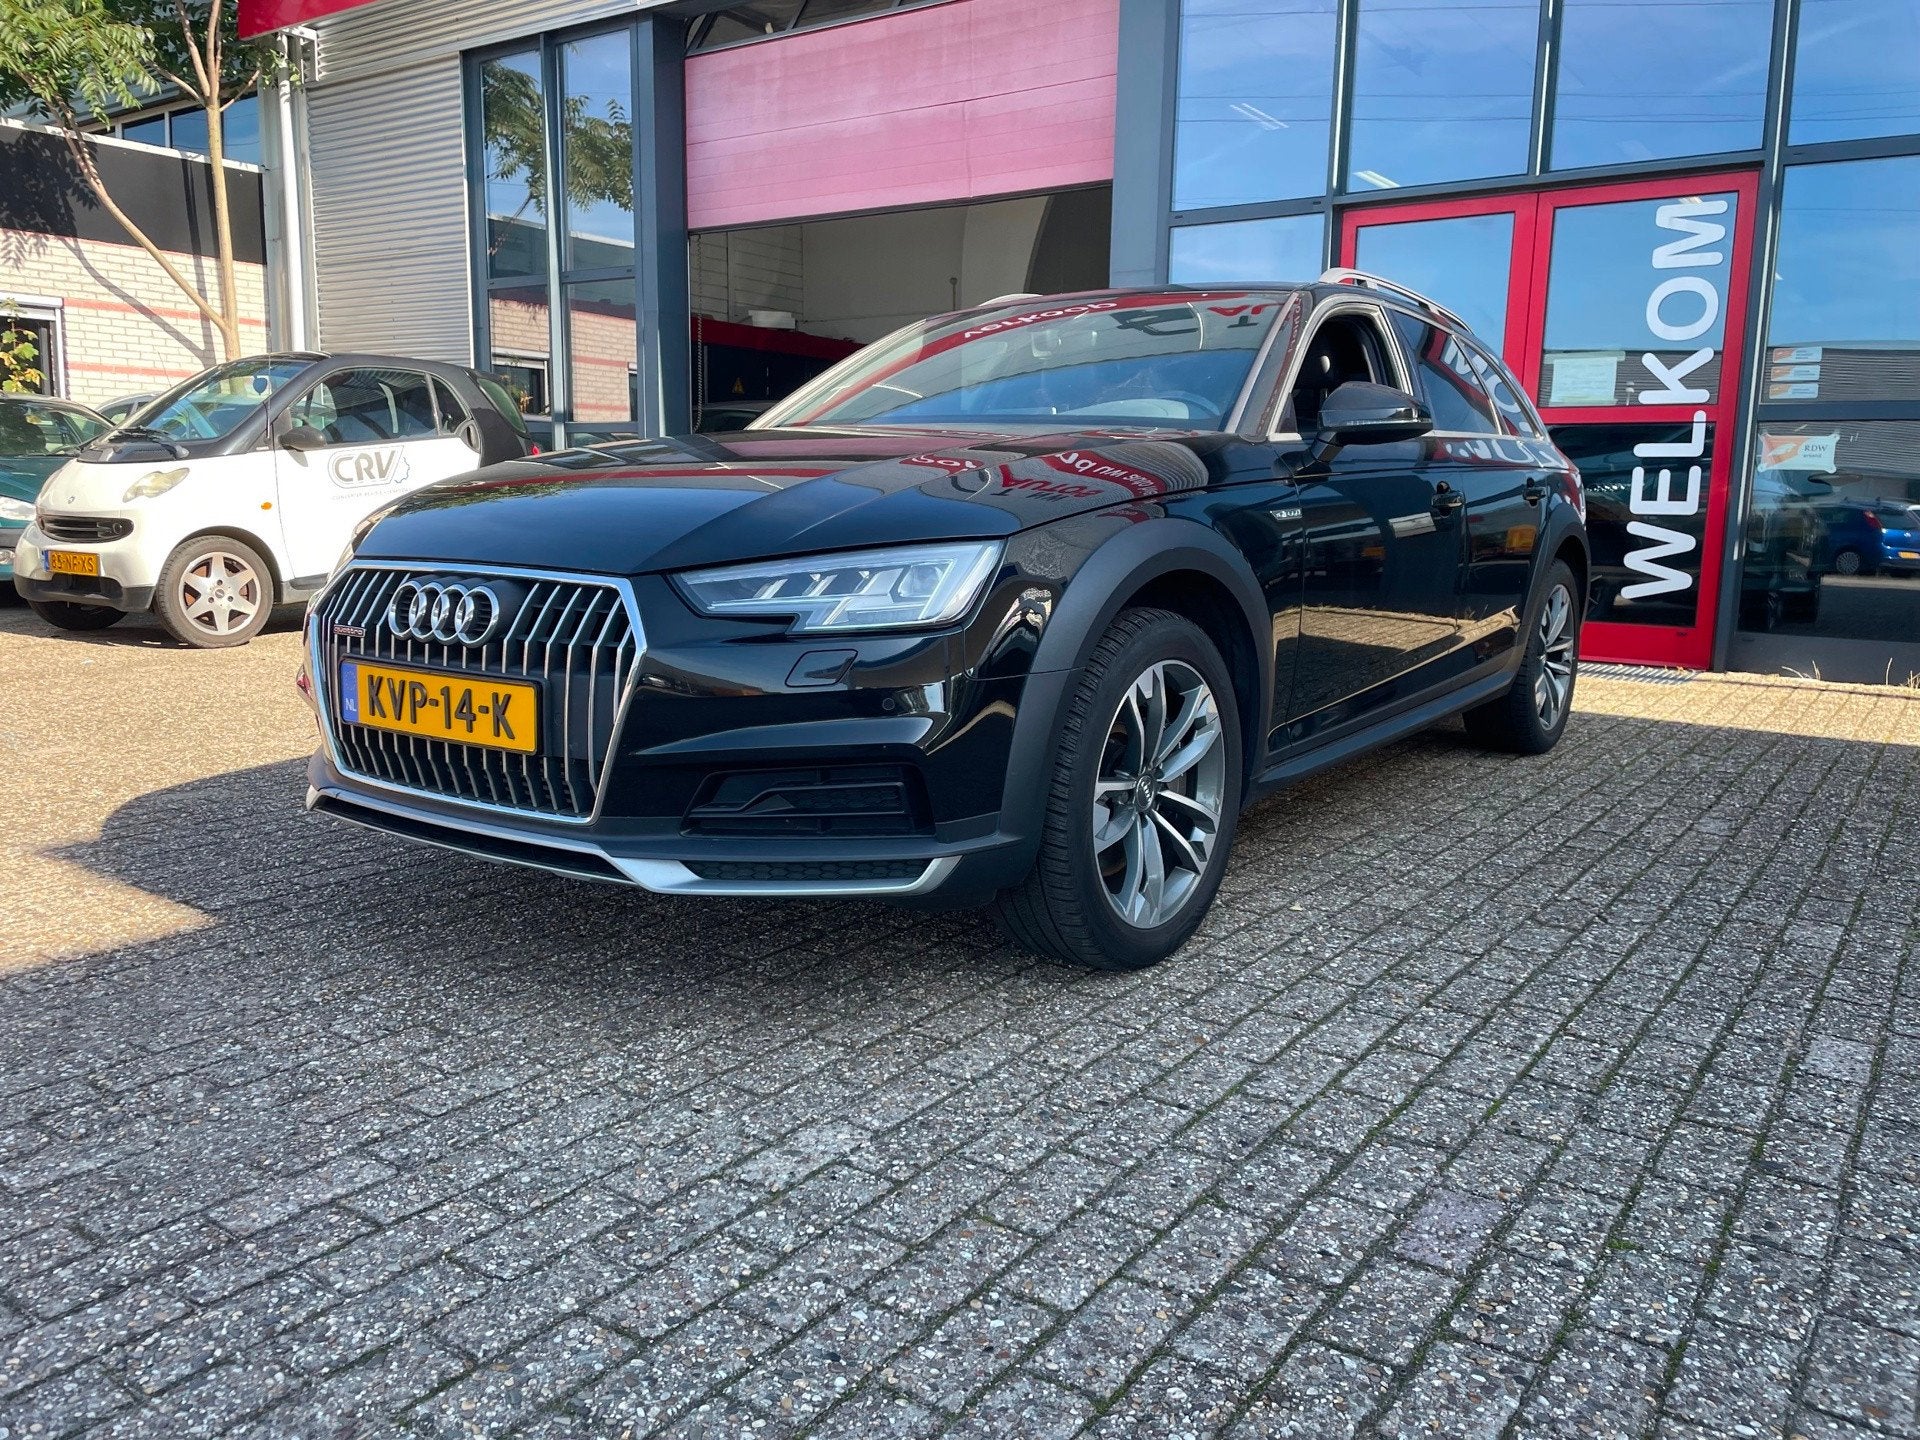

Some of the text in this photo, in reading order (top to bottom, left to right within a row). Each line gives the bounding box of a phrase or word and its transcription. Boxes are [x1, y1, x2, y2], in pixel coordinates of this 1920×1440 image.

[1620, 199, 1728, 600] WELKOM
[334, 450, 396, 482] CRV
[346, 697, 357, 712] NL
[367, 674, 516, 739] KVP-14-K
